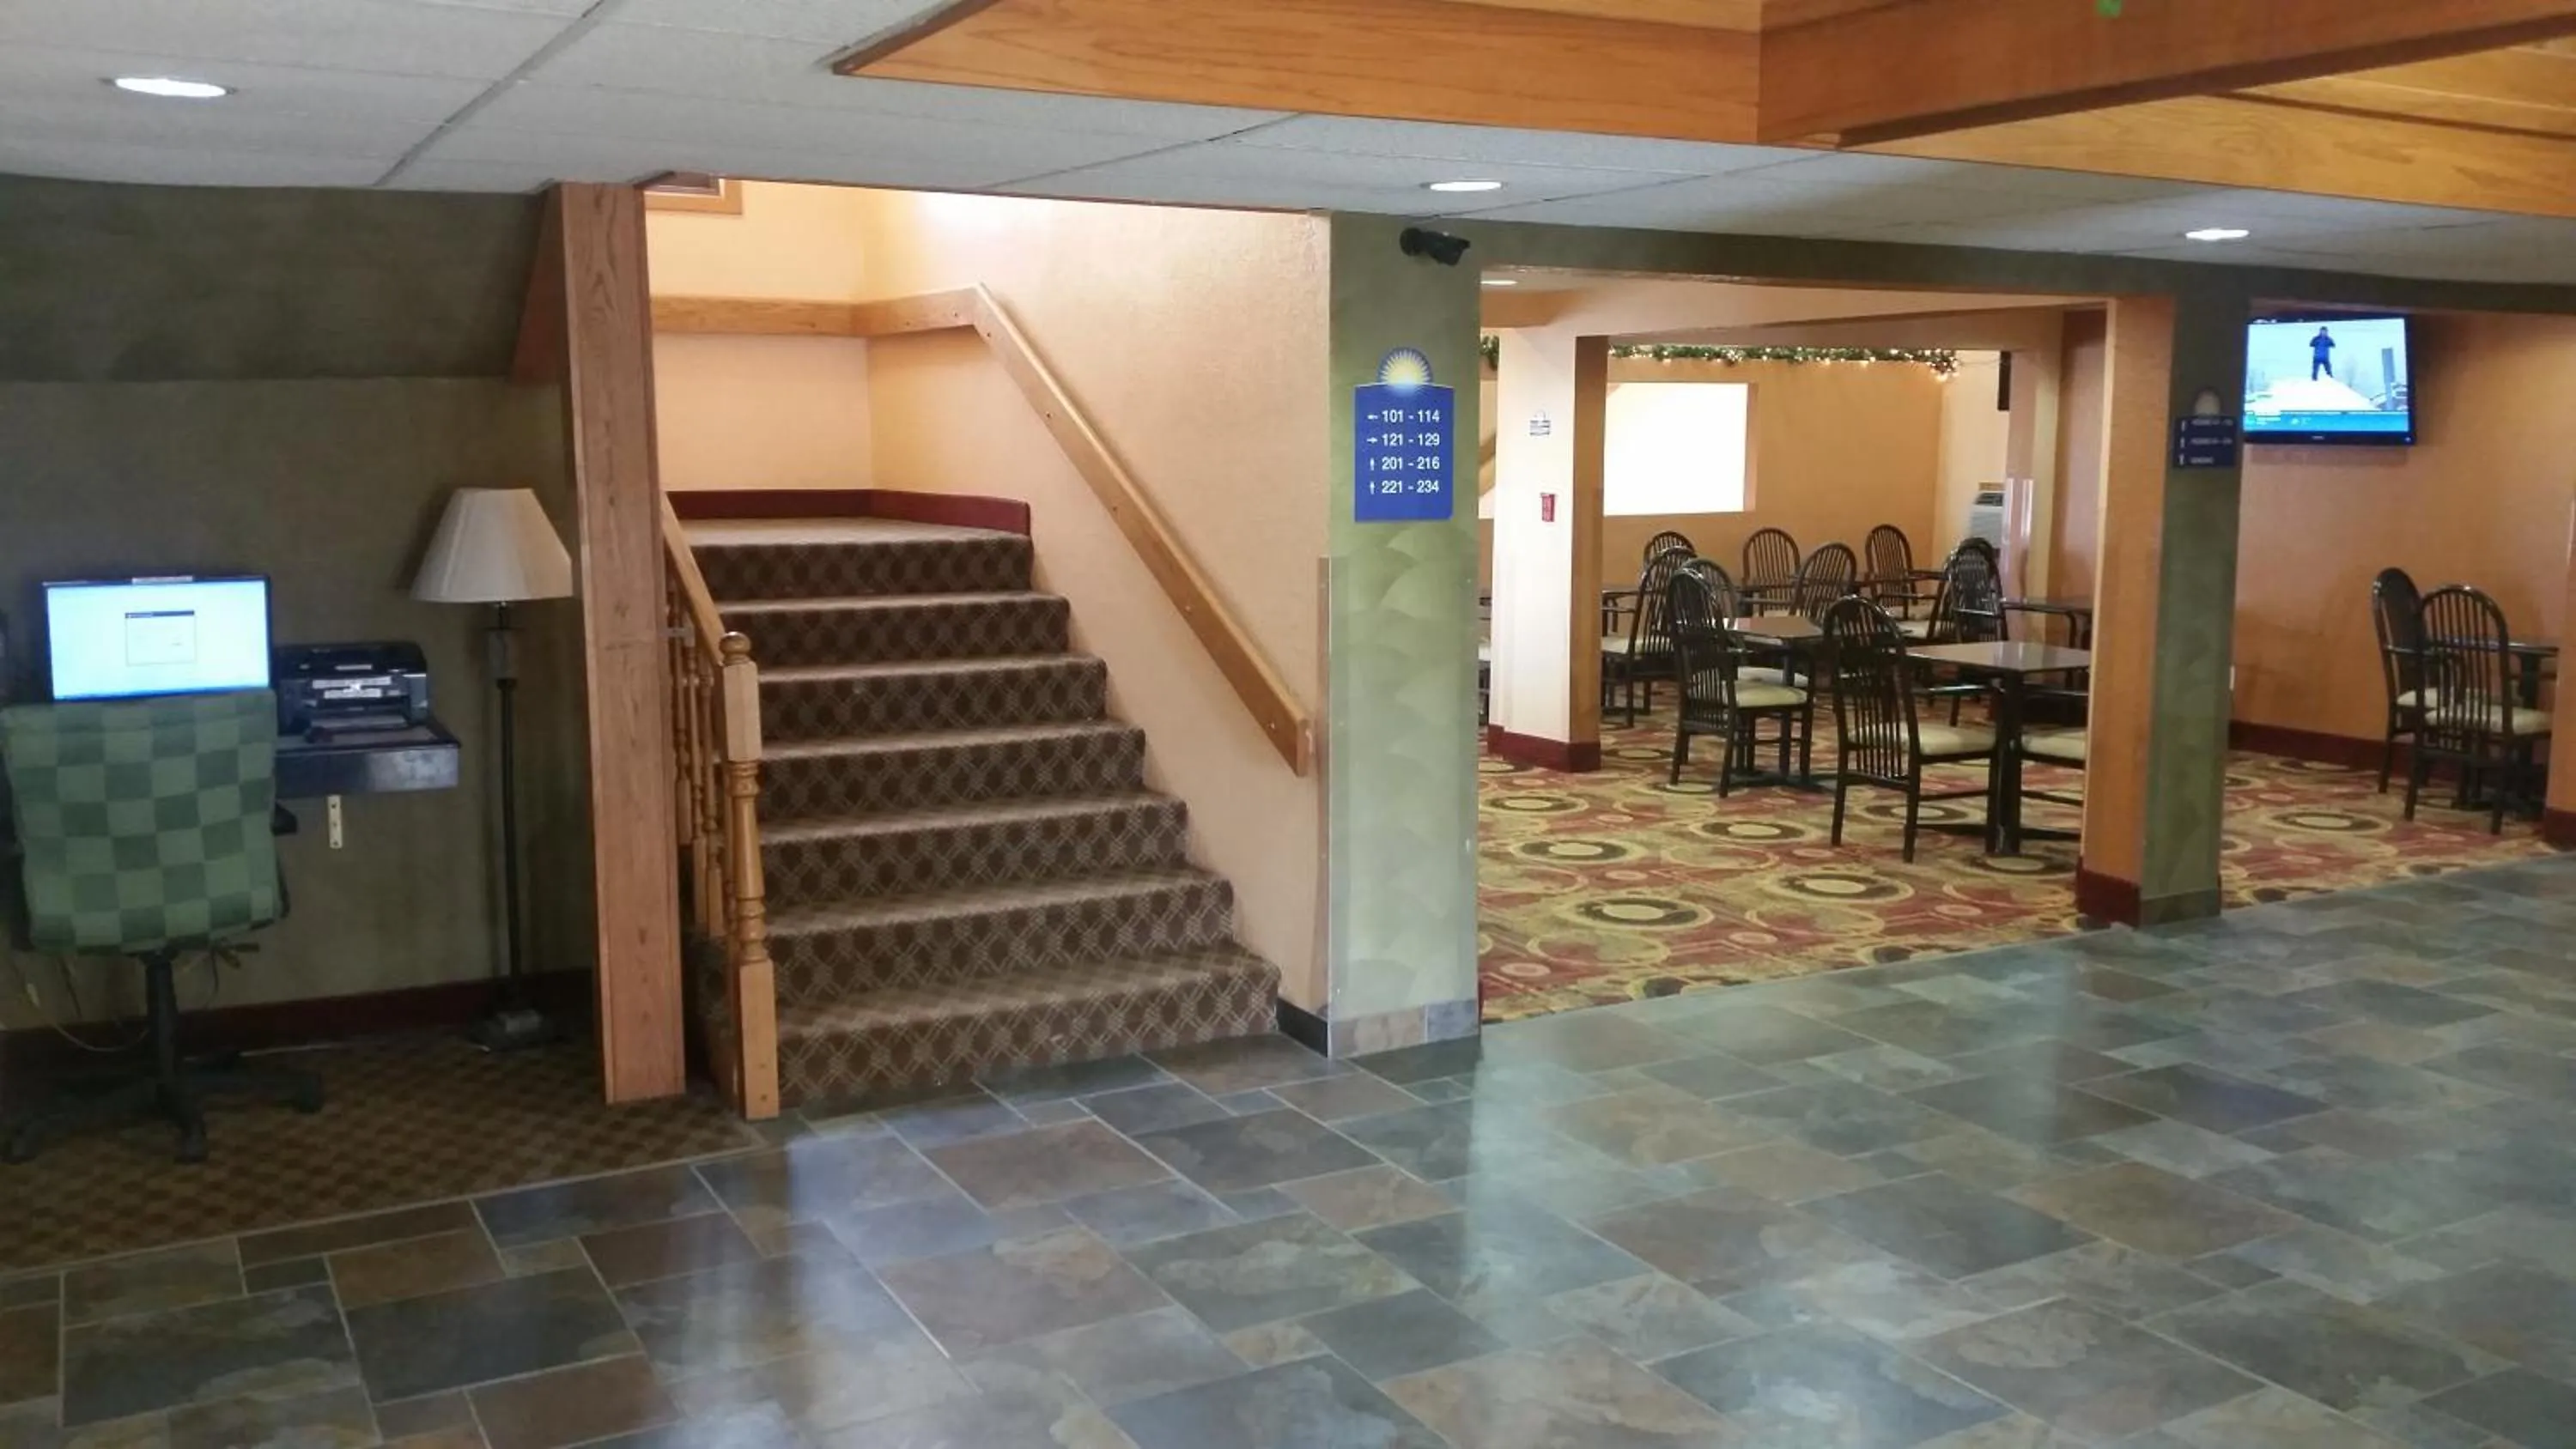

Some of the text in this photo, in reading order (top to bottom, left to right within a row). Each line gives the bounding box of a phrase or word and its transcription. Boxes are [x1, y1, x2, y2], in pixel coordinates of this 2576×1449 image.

[1382, 409, 1404, 423] 101
[1418, 409, 1440, 423] 114
[1382, 432, 1404, 446] 121
[1418, 432, 1440, 446] 129
[1382, 456, 1403, 470] 201
[1417, 456, 1440, 470] 216
[1382, 480, 1403, 494] 221
[1417, 480, 1440, 494] 234
